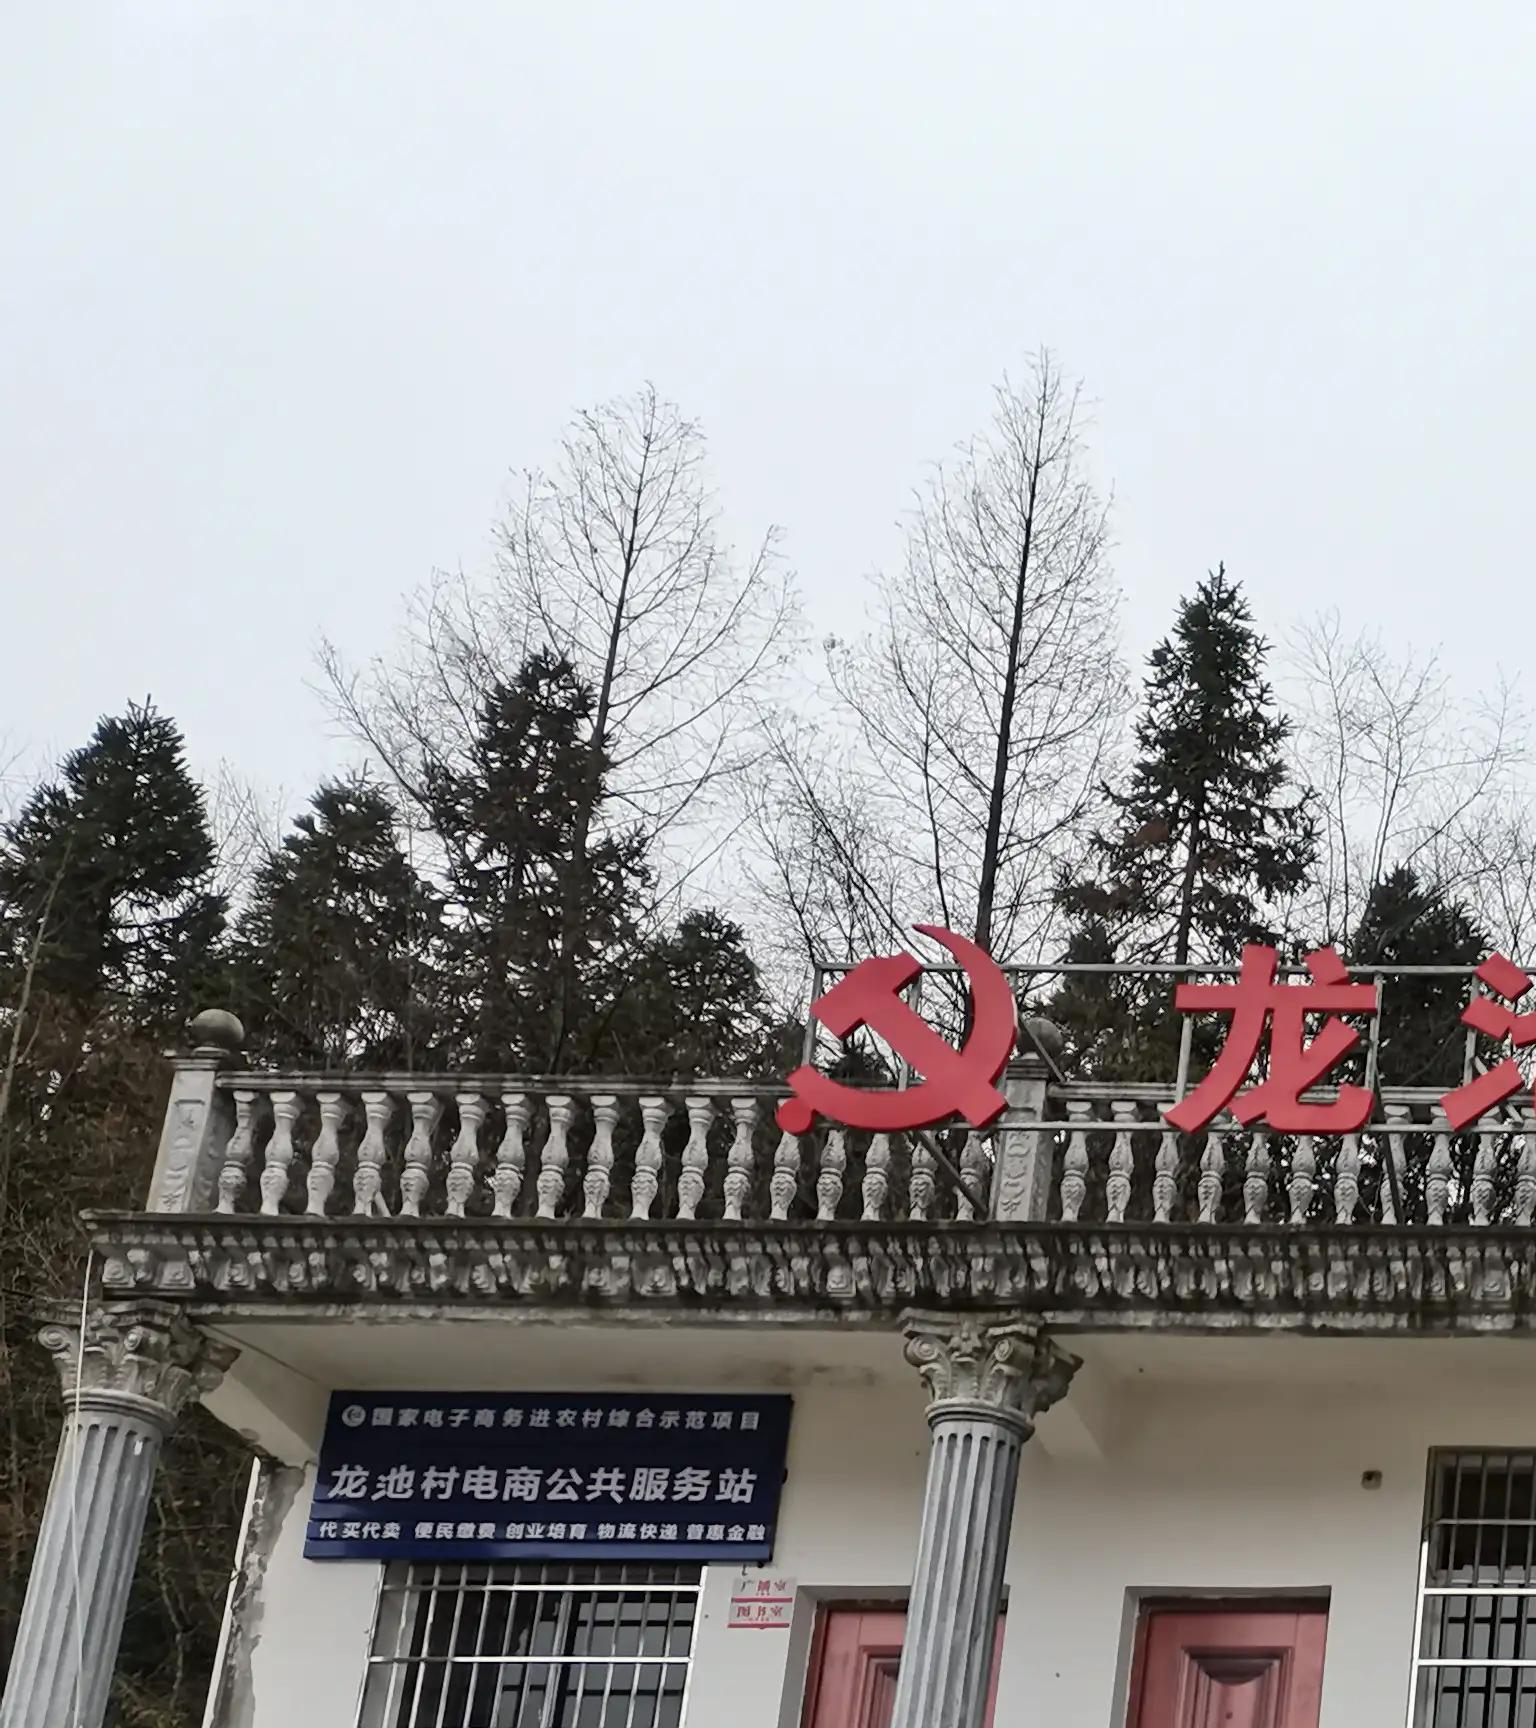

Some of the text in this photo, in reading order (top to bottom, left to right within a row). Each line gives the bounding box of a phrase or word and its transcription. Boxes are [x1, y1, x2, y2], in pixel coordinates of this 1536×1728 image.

[371, 1406, 760, 1431] 国家电子商务进农村综合示范项目
[327, 1464, 758, 1505] 龙池村电商公共服务站
[319, 1521, 401, 1540] 代买代卖
[505, 1522, 588, 1541] 创业培育
[597, 1523, 679, 1541] 物流快递
